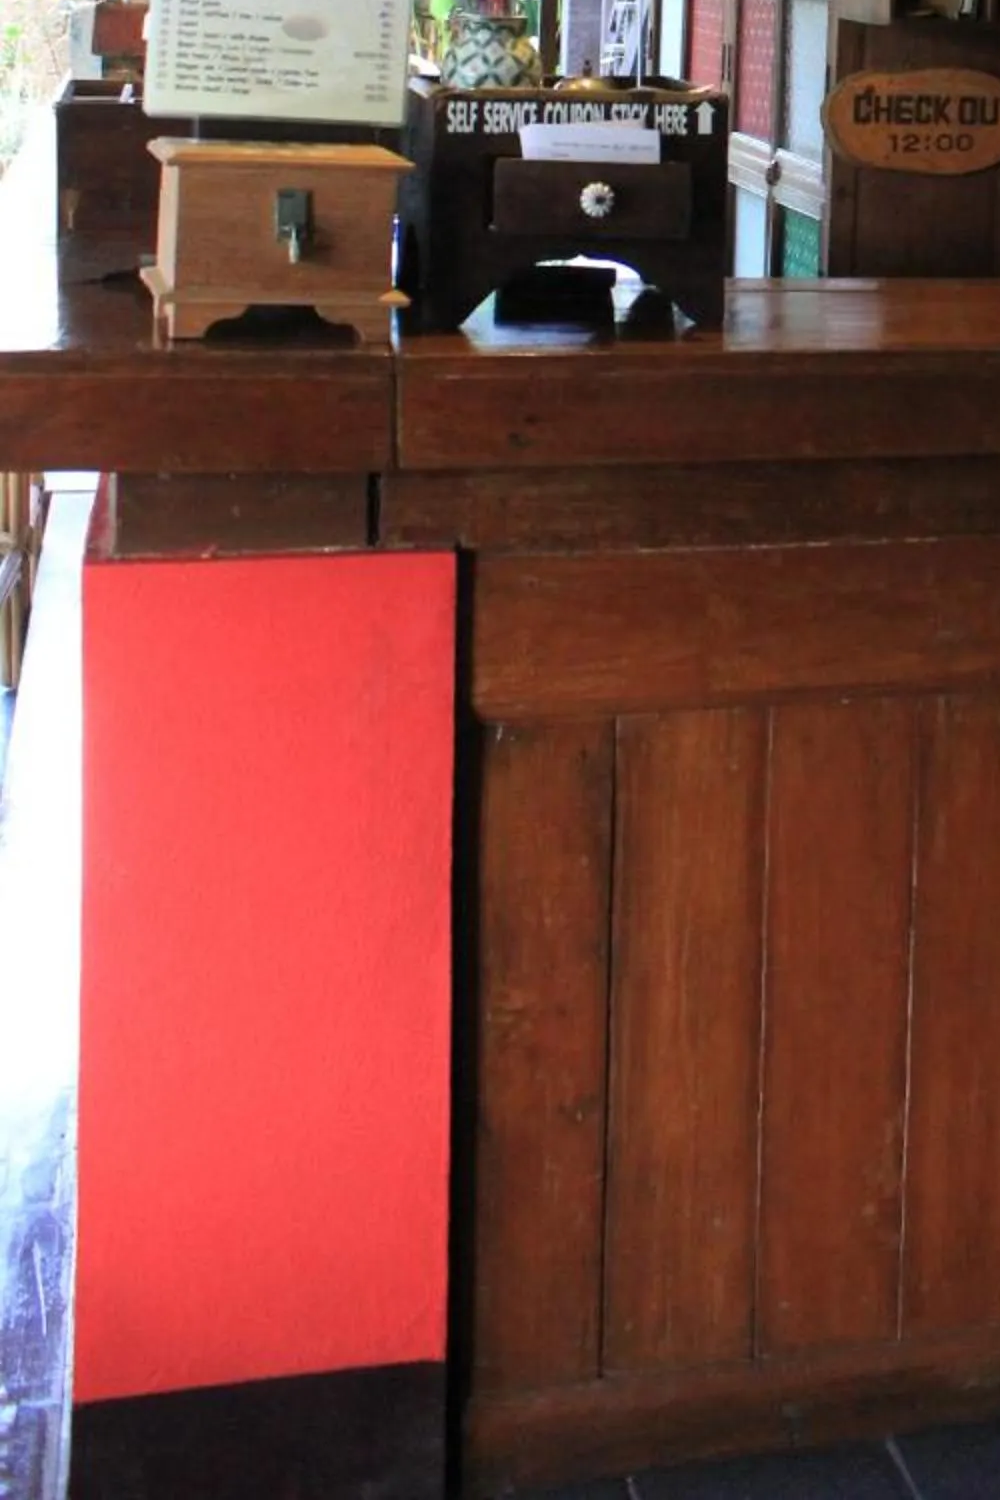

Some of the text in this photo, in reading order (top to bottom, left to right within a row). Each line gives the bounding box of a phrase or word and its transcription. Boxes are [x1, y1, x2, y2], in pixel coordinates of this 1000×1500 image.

[447, 101, 478, 134] SELF
[484, 102, 538, 134] SERVICE
[654, 104, 688, 135] HERE
[853, 89, 951, 125] CHECK
[888, 133, 975, 153] 12:00
